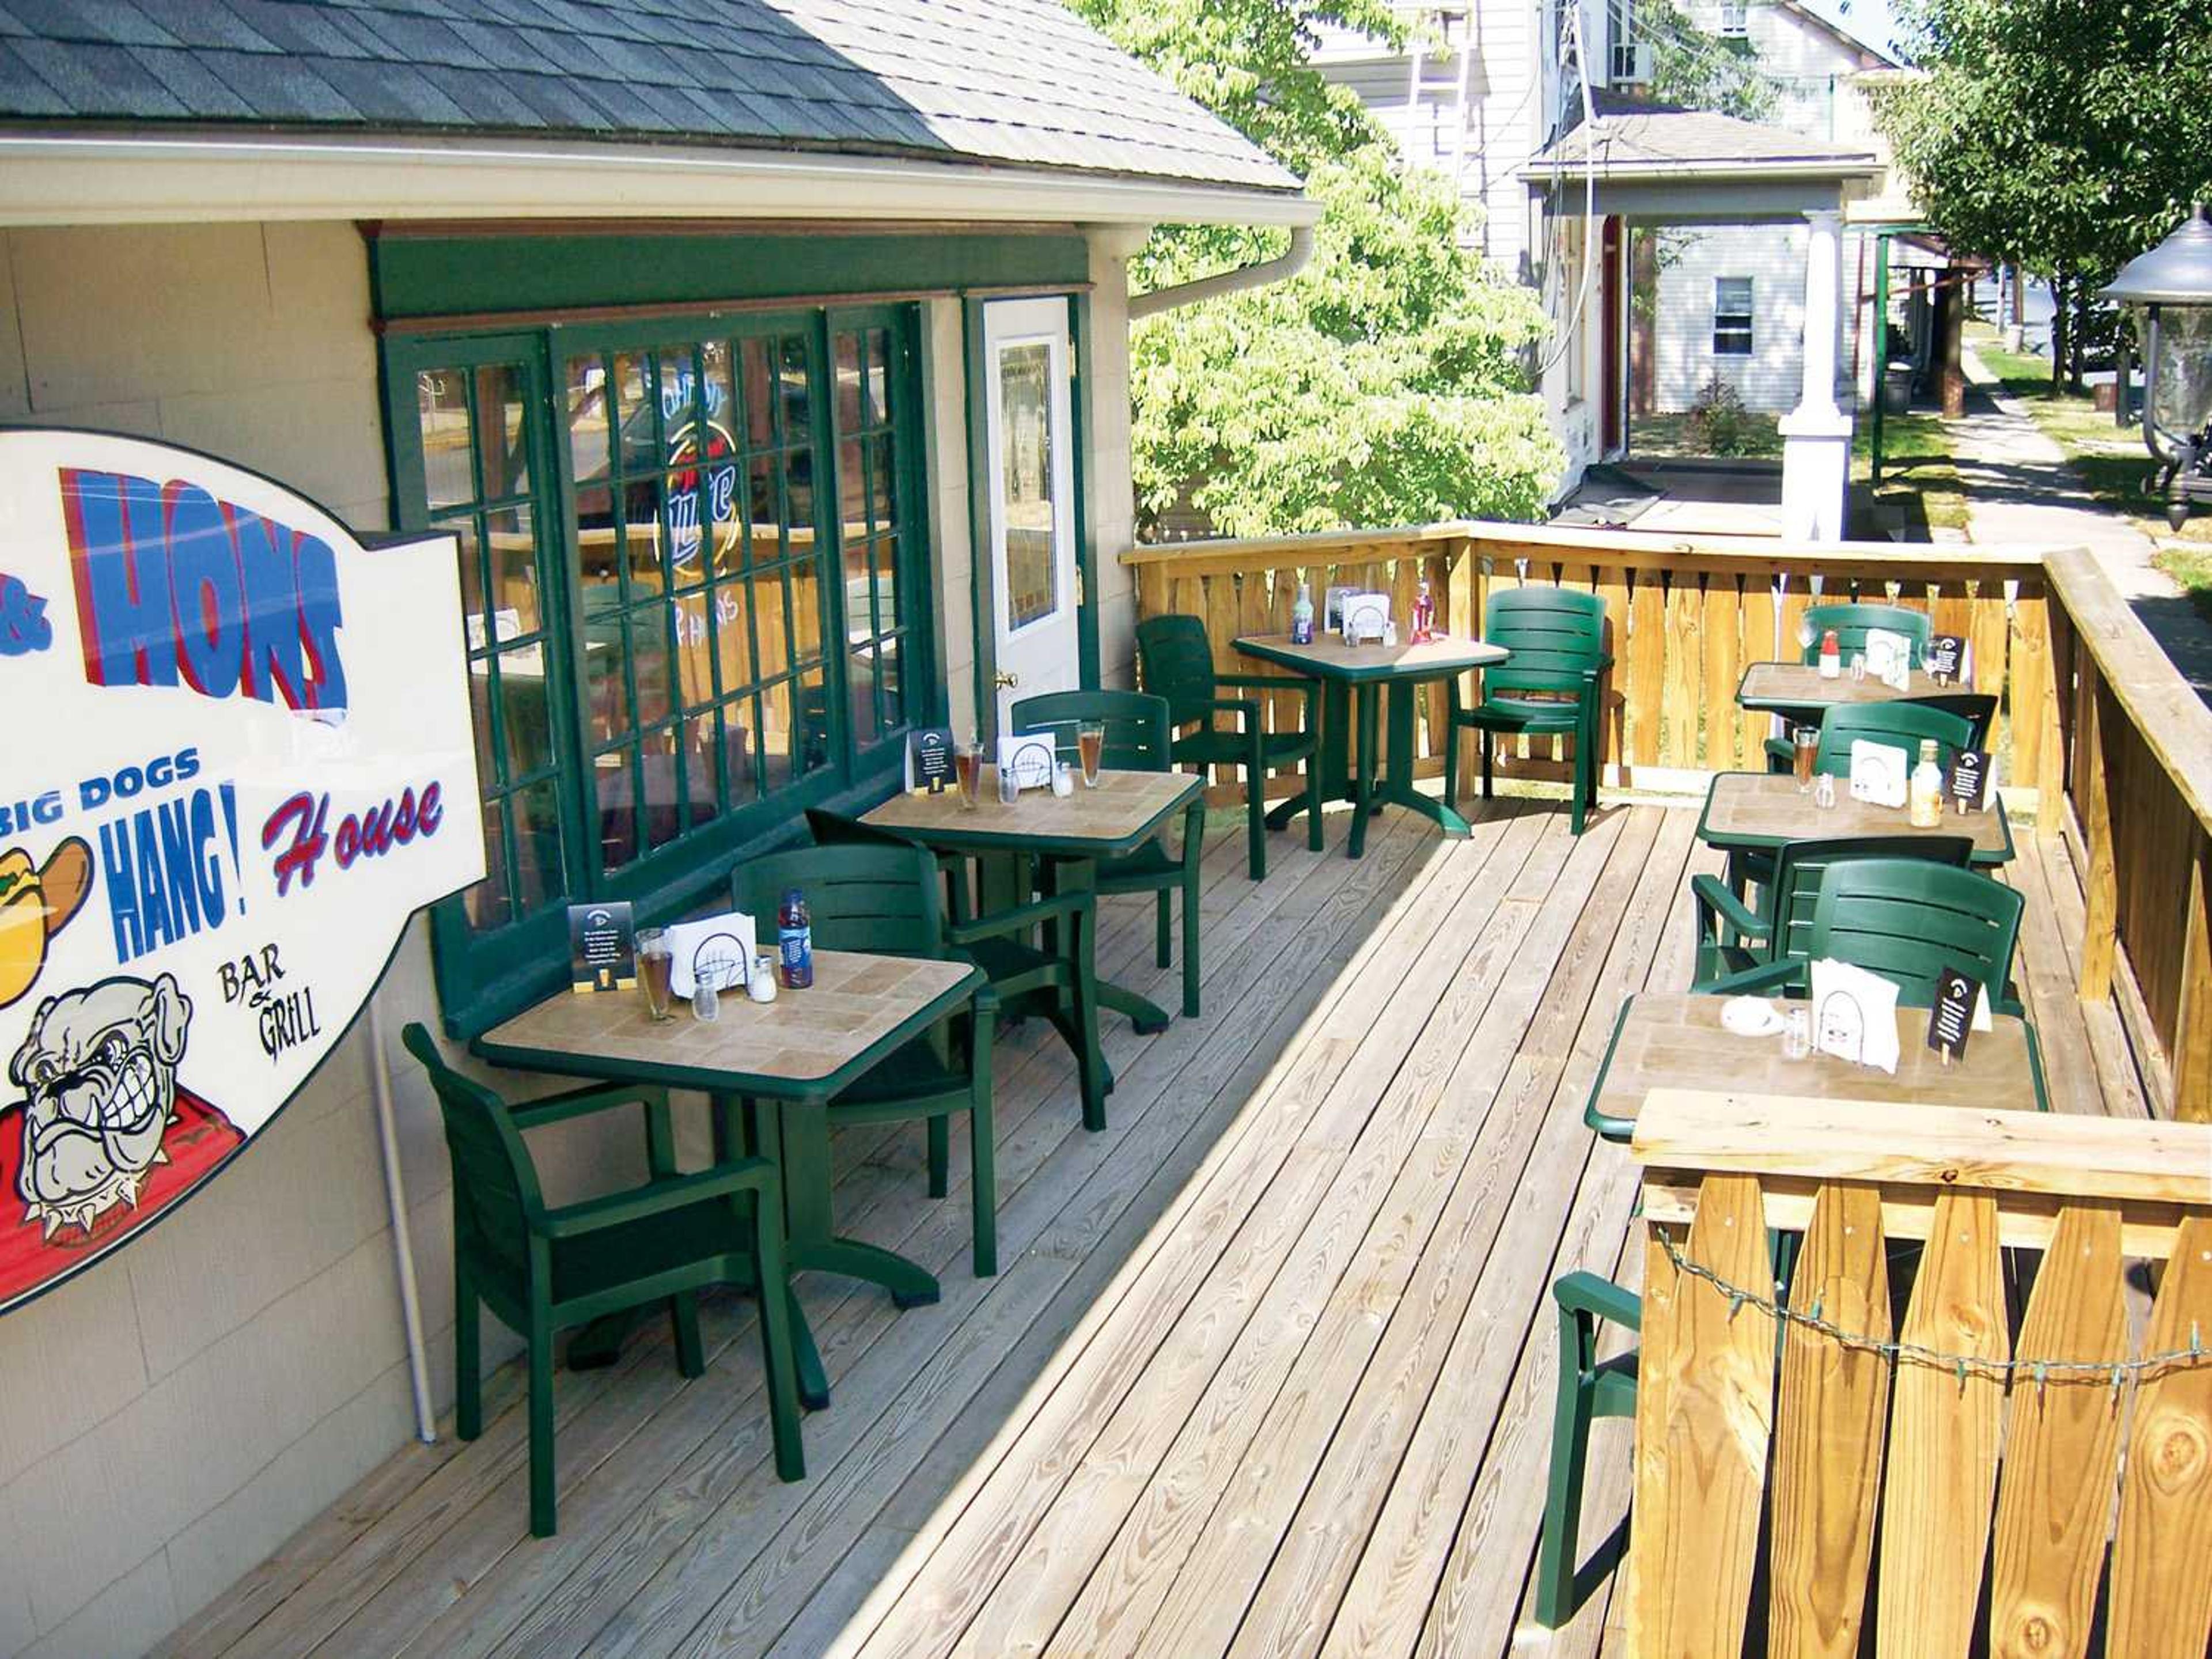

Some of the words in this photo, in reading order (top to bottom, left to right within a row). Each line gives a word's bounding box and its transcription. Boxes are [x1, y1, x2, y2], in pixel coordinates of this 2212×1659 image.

[79, 748, 200, 811] DOGS
[262, 781, 444, 897] House
[99, 779, 246, 964] HANG!
[217, 943, 286, 1006] BAR
[249, 989, 272, 1008] &
